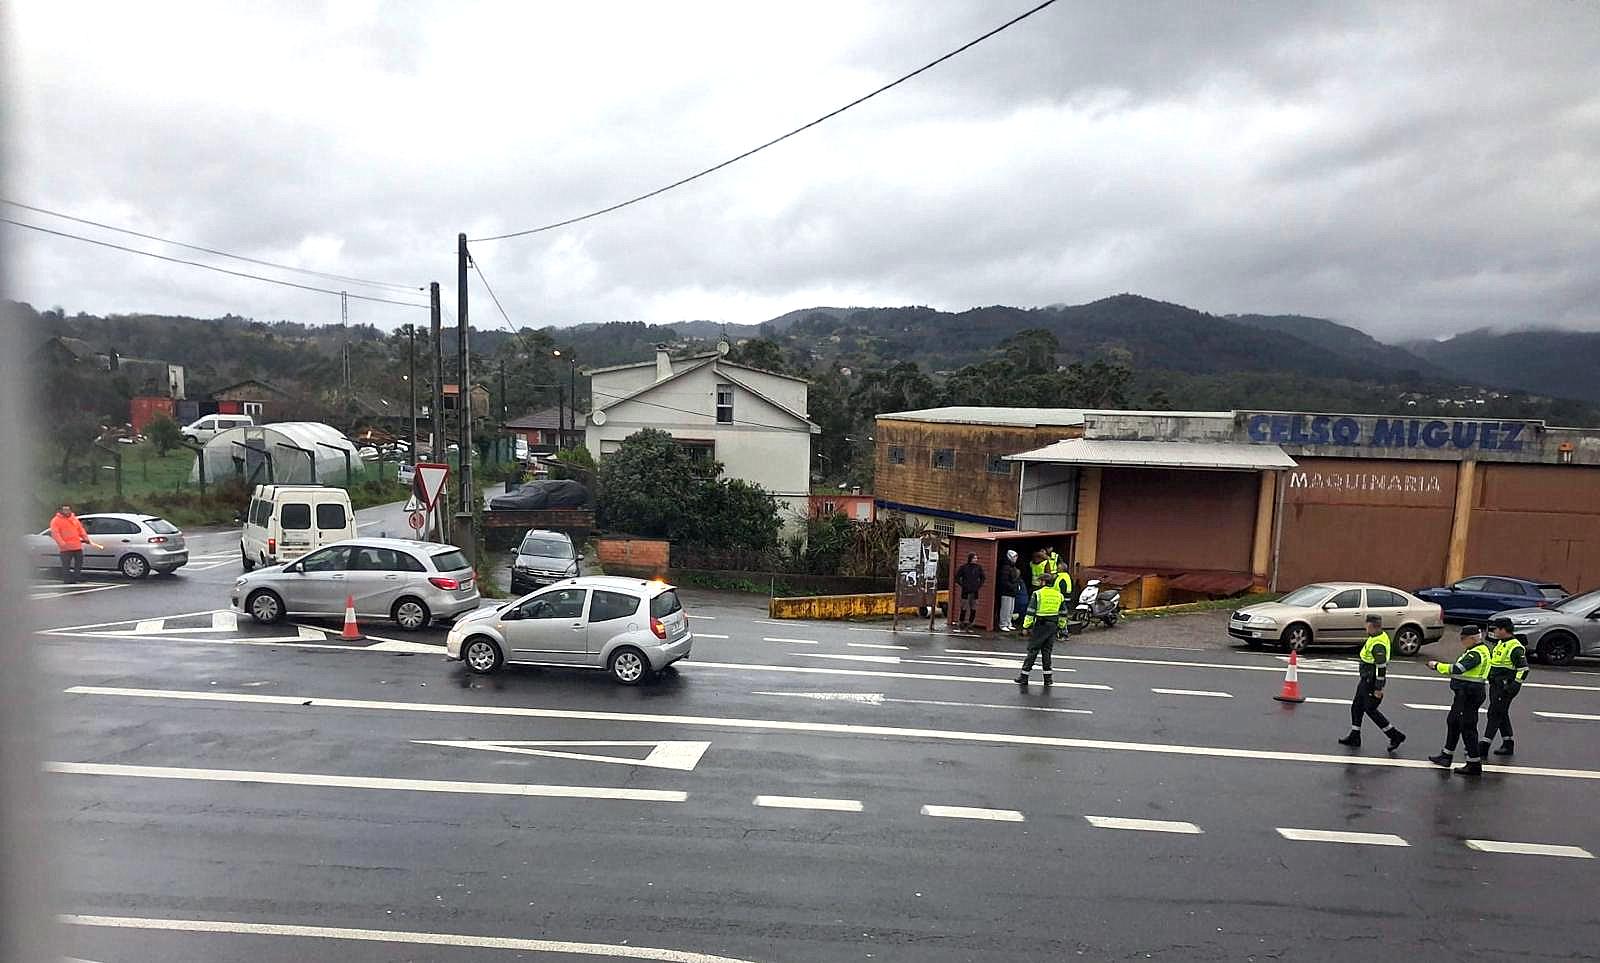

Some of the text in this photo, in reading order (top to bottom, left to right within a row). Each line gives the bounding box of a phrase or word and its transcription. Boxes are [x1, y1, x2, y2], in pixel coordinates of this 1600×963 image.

[1247, 413, 1528, 450] CELSO MIGUEZ
[1289, 471, 1441, 493] MAQUINARIA
